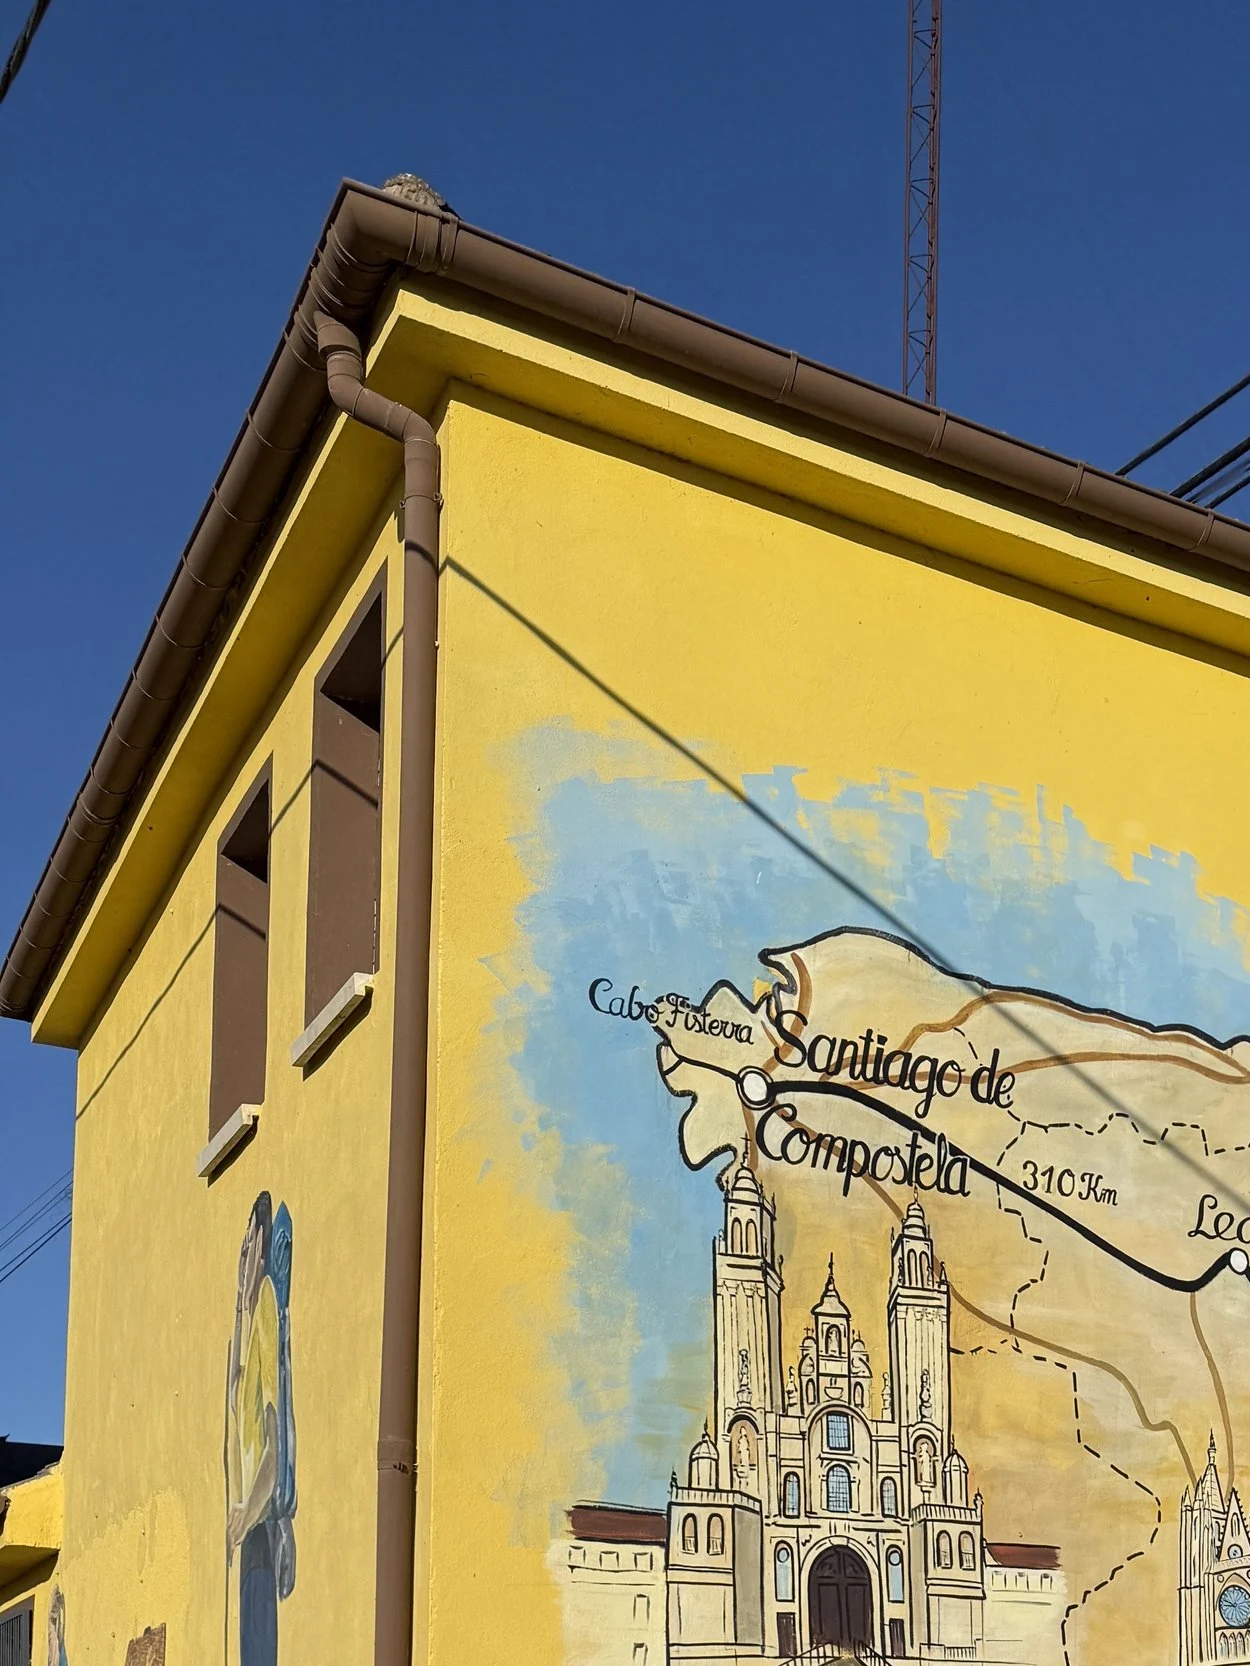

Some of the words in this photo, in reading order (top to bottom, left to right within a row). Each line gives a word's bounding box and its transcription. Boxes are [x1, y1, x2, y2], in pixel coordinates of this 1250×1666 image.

[589, 978, 662, 1024] Cabo
[665, 993, 754, 1045] Fisterra
[774, 1010, 965, 1117] Santiago
[970, 1048, 1016, 1108] de
[755, 1103, 971, 1197] Compostela
[1022, 1160, 1076, 1197] 310
[1080, 1171, 1119, 1206] Km
